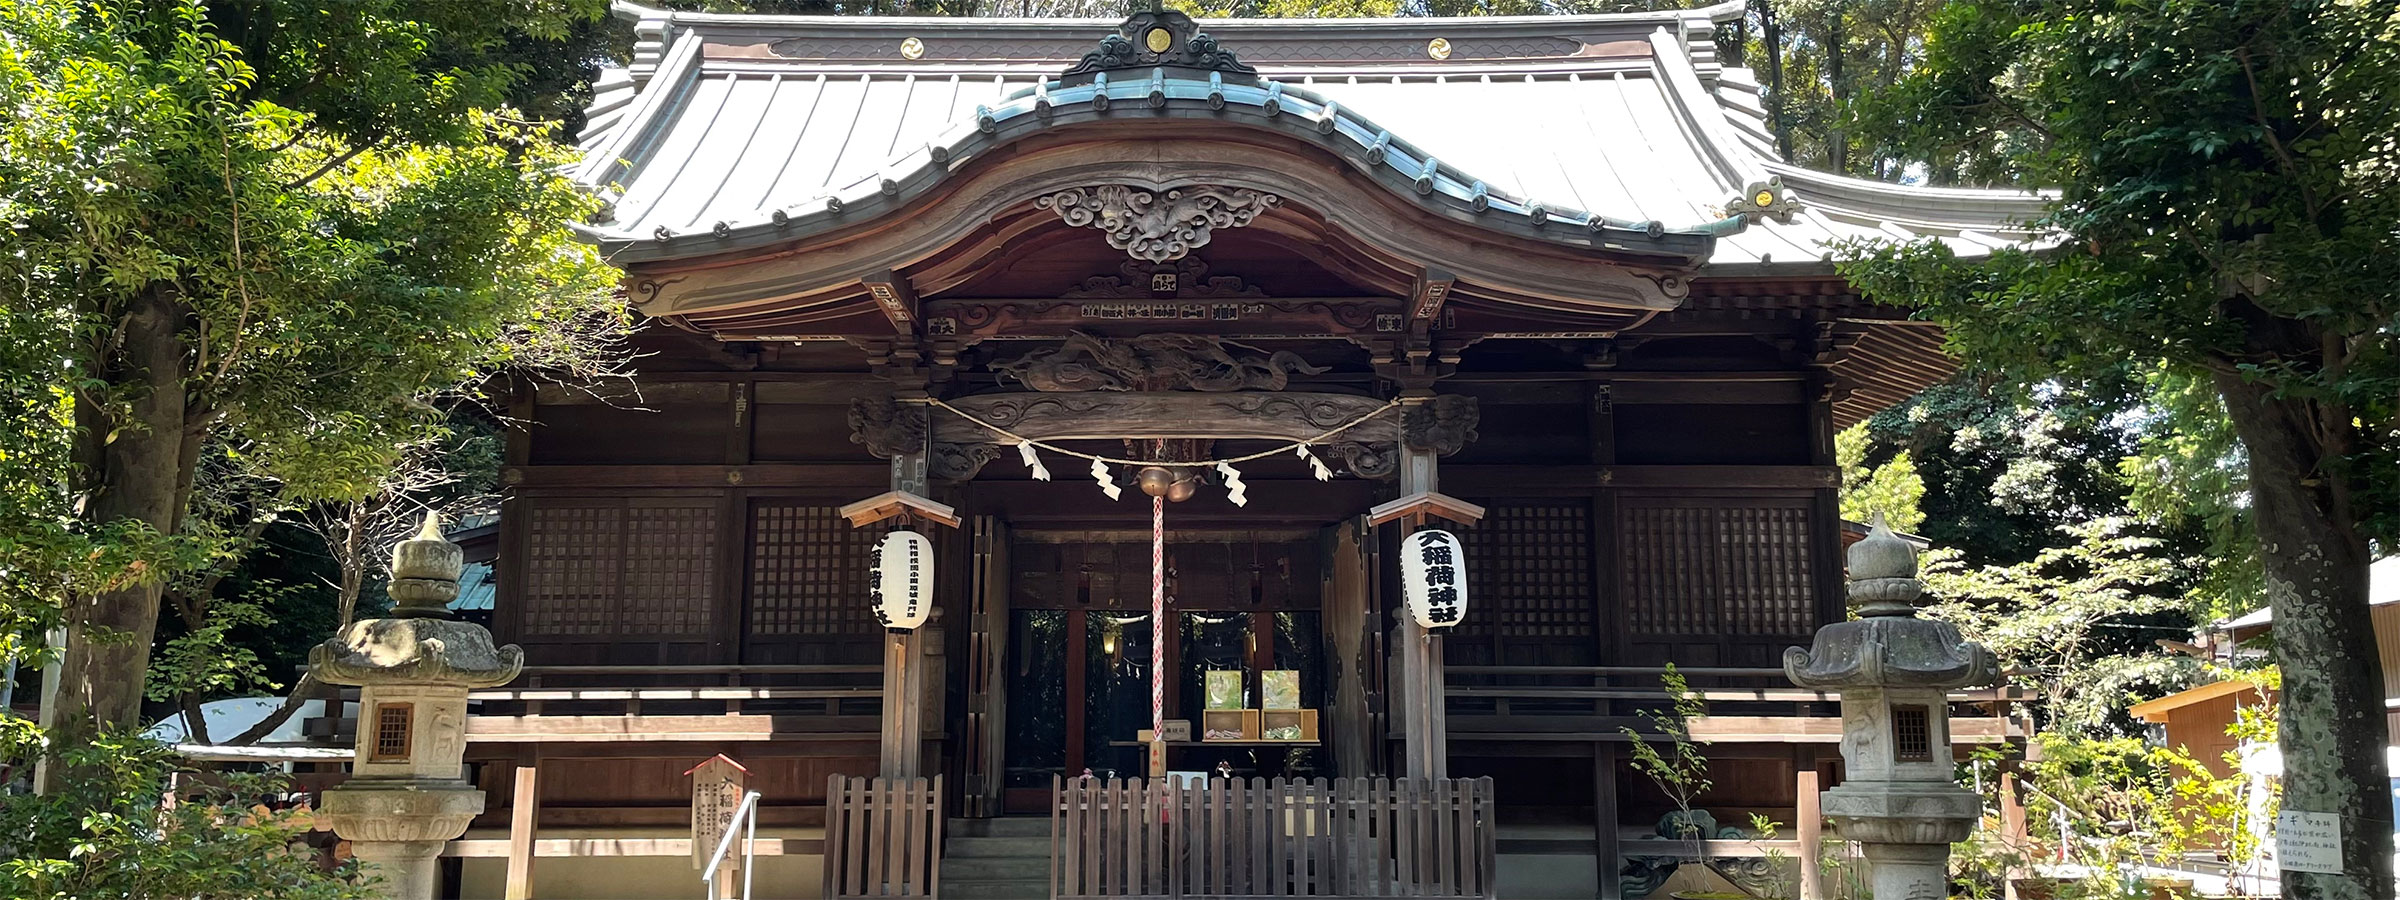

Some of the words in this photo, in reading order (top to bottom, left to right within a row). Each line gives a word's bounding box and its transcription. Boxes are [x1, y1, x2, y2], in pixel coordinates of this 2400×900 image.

[1418, 532, 1458, 623] 大稲荷神社
